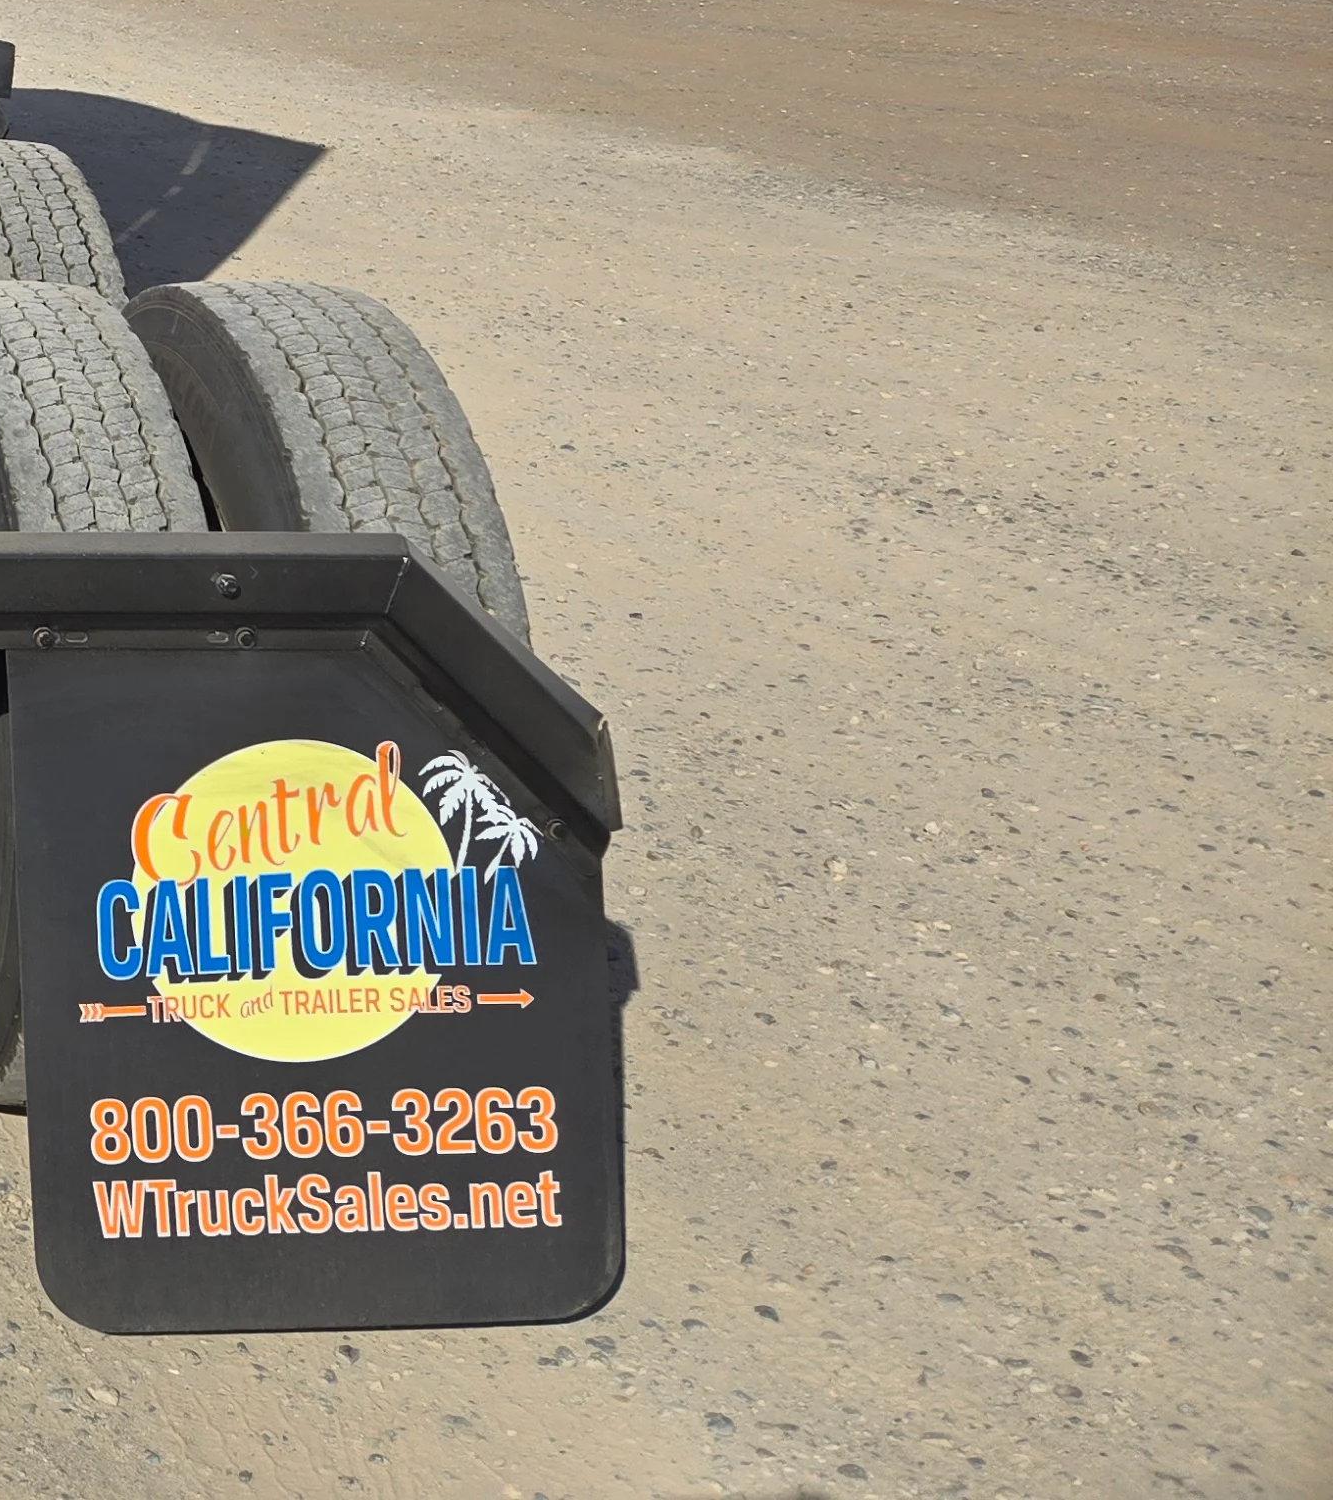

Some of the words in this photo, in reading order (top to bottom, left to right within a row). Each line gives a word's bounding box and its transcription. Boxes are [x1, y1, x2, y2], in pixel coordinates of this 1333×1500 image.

[130, 740, 408, 888] Central
[95, 865, 537, 981] CALIFORNIA
[146, 993, 231, 1023] TRUCK
[240, 984, 275, 1020] and
[279, 989, 381, 1017] TRAILER
[389, 984, 472, 1014] SALES
[89, 1086, 559, 1165] 800-366-3263
[92, 1169, 563, 1240] WTruckSales.net
